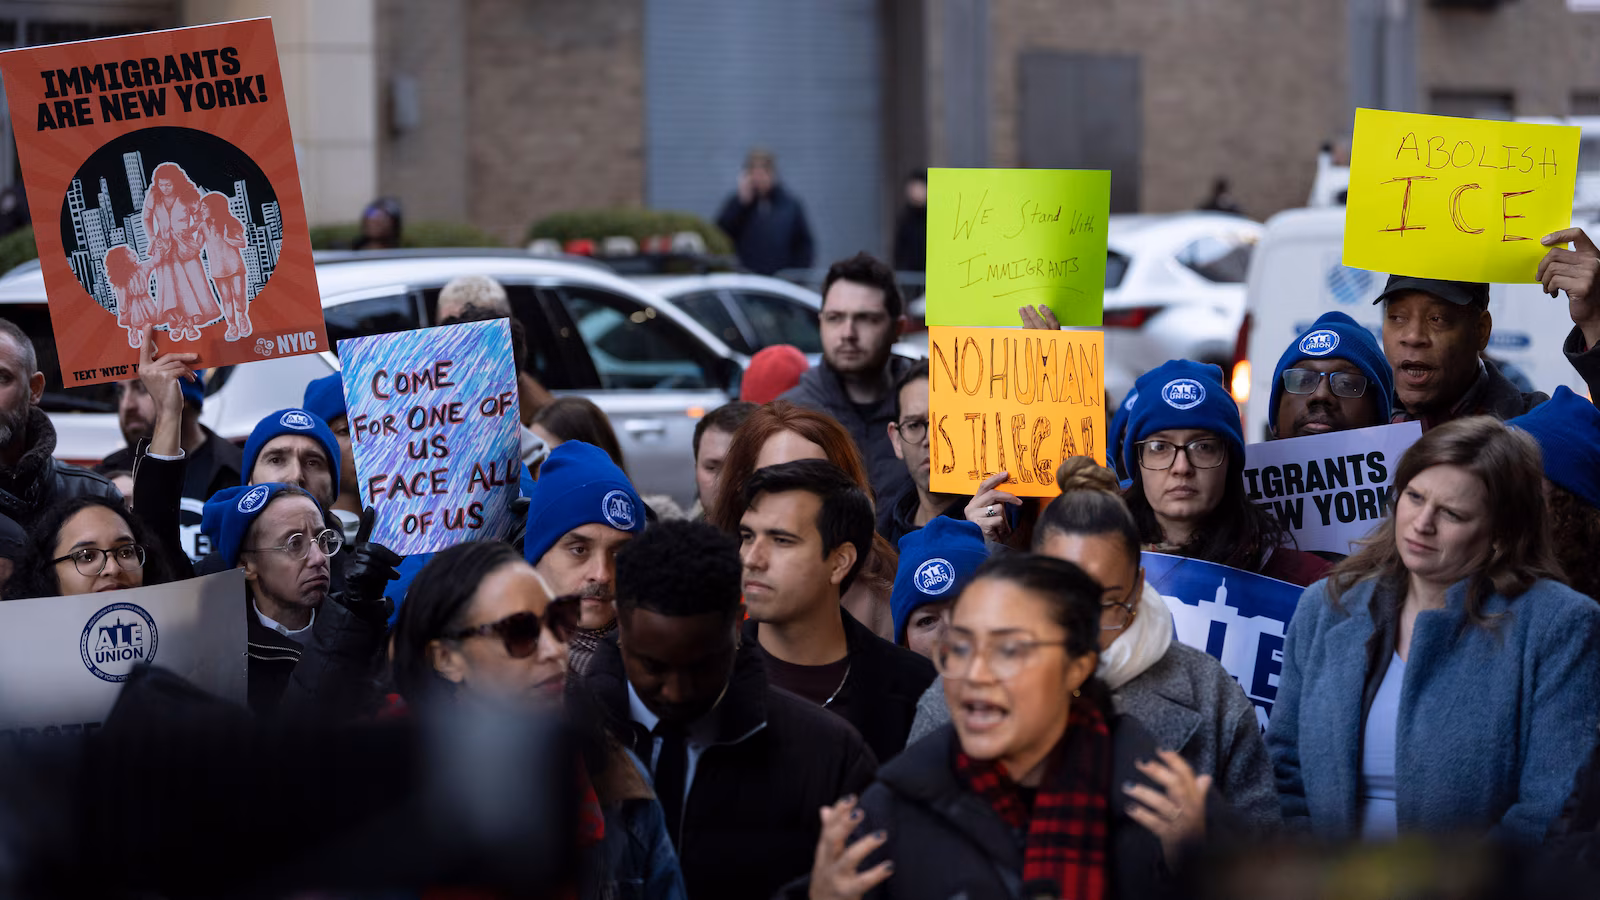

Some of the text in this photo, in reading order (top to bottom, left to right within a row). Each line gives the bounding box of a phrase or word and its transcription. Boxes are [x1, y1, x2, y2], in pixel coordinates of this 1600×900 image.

[40, 47, 241, 99] IMMIGRANTS
[37, 74, 268, 131] ARE NEW YORK!
[1396, 131, 1558, 179] ABOLISH
[1003, 200, 1062, 239] Stand
[1069, 210, 1094, 235] With
[1378, 176, 1535, 242] ICE
[958, 252, 1079, 288] IMMIGRANTS
[276, 330, 317, 354] NYIC
[1305, 341, 1330, 350] UNION
[73, 369, 97, 381] TEXT
[131, 363, 140, 373] T
[371, 360, 455, 400] COME
[932, 336, 1100, 406] NO HUMAN
[1171, 384, 1197, 394] ALE
[353, 392, 513, 443] FOR ONE OF
[408, 434, 450, 460] US
[932, 412, 955, 474] IS
[368, 459, 519, 503] FACE ALL
[402, 501, 484, 534] OF US
[610, 508, 632, 522] UNION
[611, 497, 631, 513] ALE
[1312, 485, 1393, 526] YORK
[921, 564, 945, 580] ALE
[923, 573, 948, 588] UNION
[95, 624, 143, 651] ALE
[96, 647, 143, 663] UNION
[1171, 612, 1286, 701] LE
